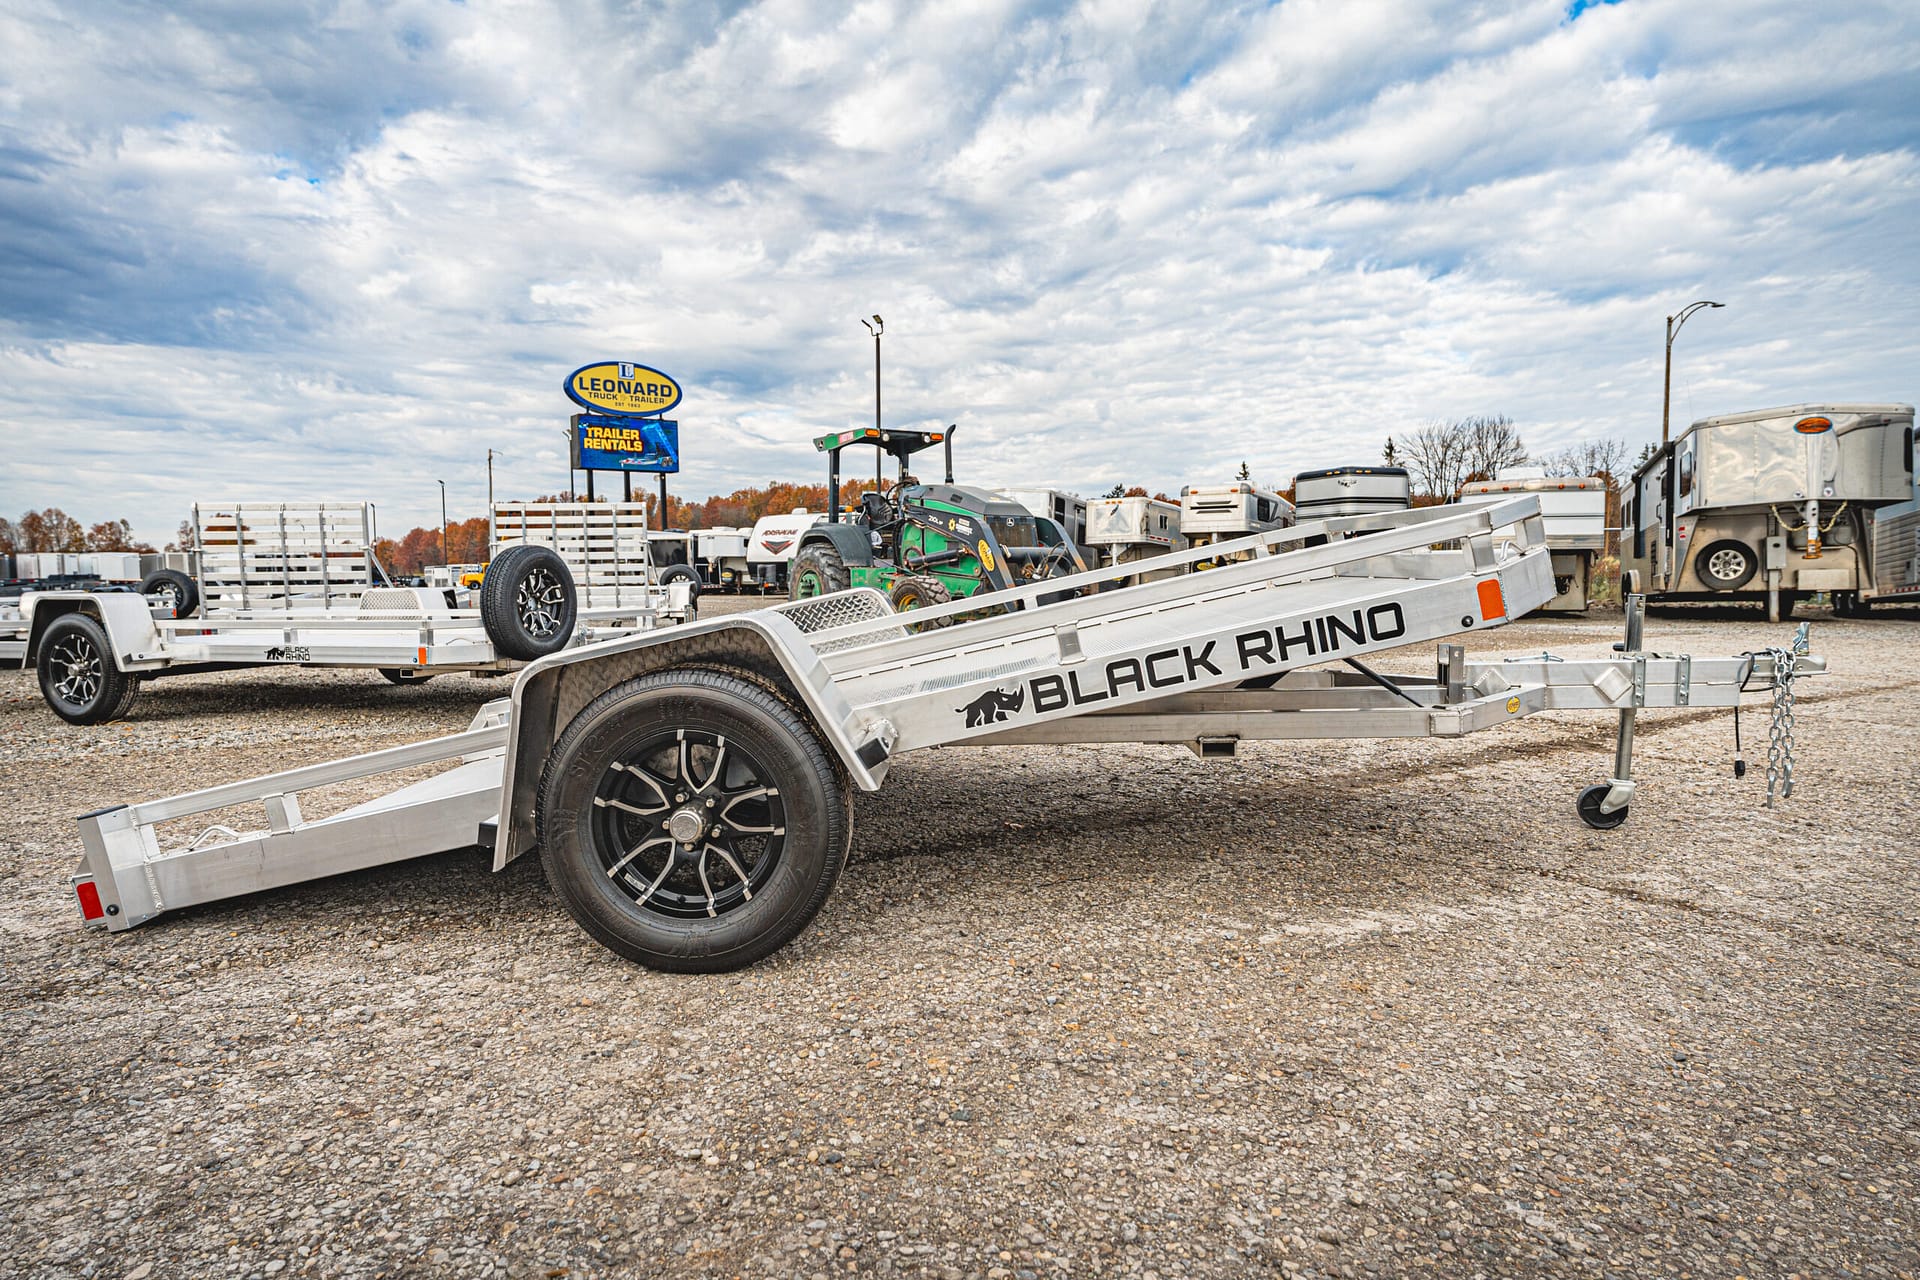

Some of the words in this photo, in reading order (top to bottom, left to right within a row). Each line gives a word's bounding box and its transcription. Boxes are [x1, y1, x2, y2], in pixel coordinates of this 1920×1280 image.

[579, 377, 672, 397] LEONARD
[588, 392, 618, 400] TRUCK
[630, 395, 665, 404] TRAILER
[586, 426, 640, 440] TRAILER
[583, 438, 643, 452] RENTALS
[286, 653, 311, 661] RHINO
[1029, 640, 1223, 715] BLACK
[1235, 602, 1406, 670] RHINO
